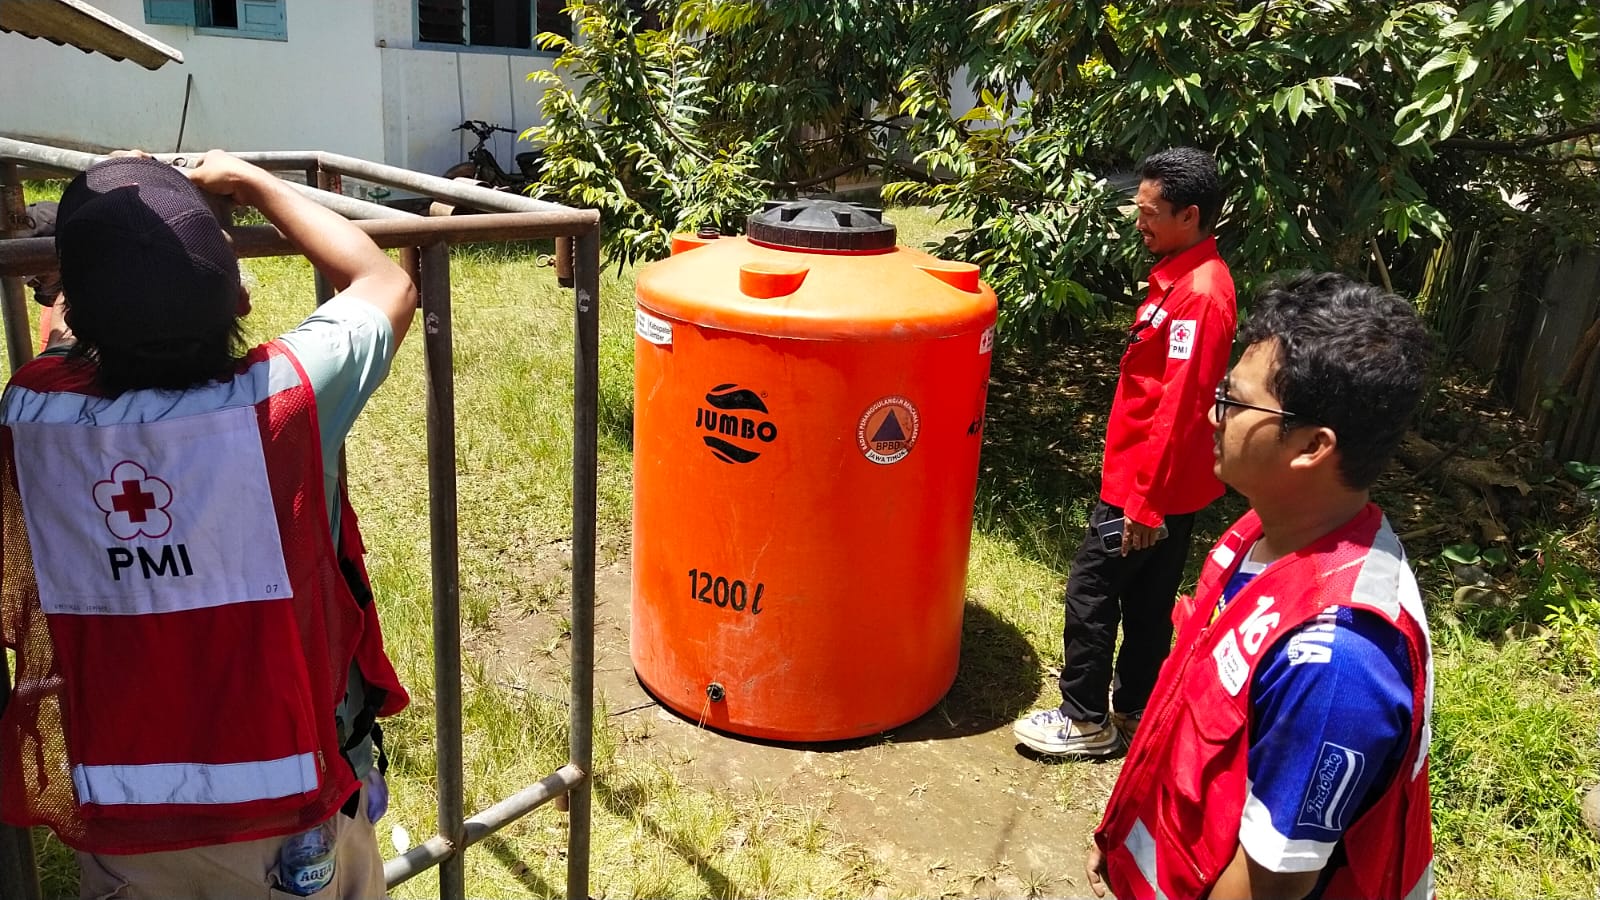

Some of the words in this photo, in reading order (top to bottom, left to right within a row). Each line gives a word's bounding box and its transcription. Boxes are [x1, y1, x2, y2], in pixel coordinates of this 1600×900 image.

[1172, 345, 1188, 354] PMI
[695, 407, 778, 443] JUMBO
[868, 451, 886, 463] JAWA
[886, 450, 907, 463] TIMUR
[876, 441, 901, 451] BPBD
[106, 544, 194, 581] PMI
[265, 584, 278, 594] 07
[688, 568, 748, 612] 1200
[1238, 595, 1281, 656] 16
[1306, 753, 1343, 823] Indomie
[300, 863, 332, 882] AQUA
